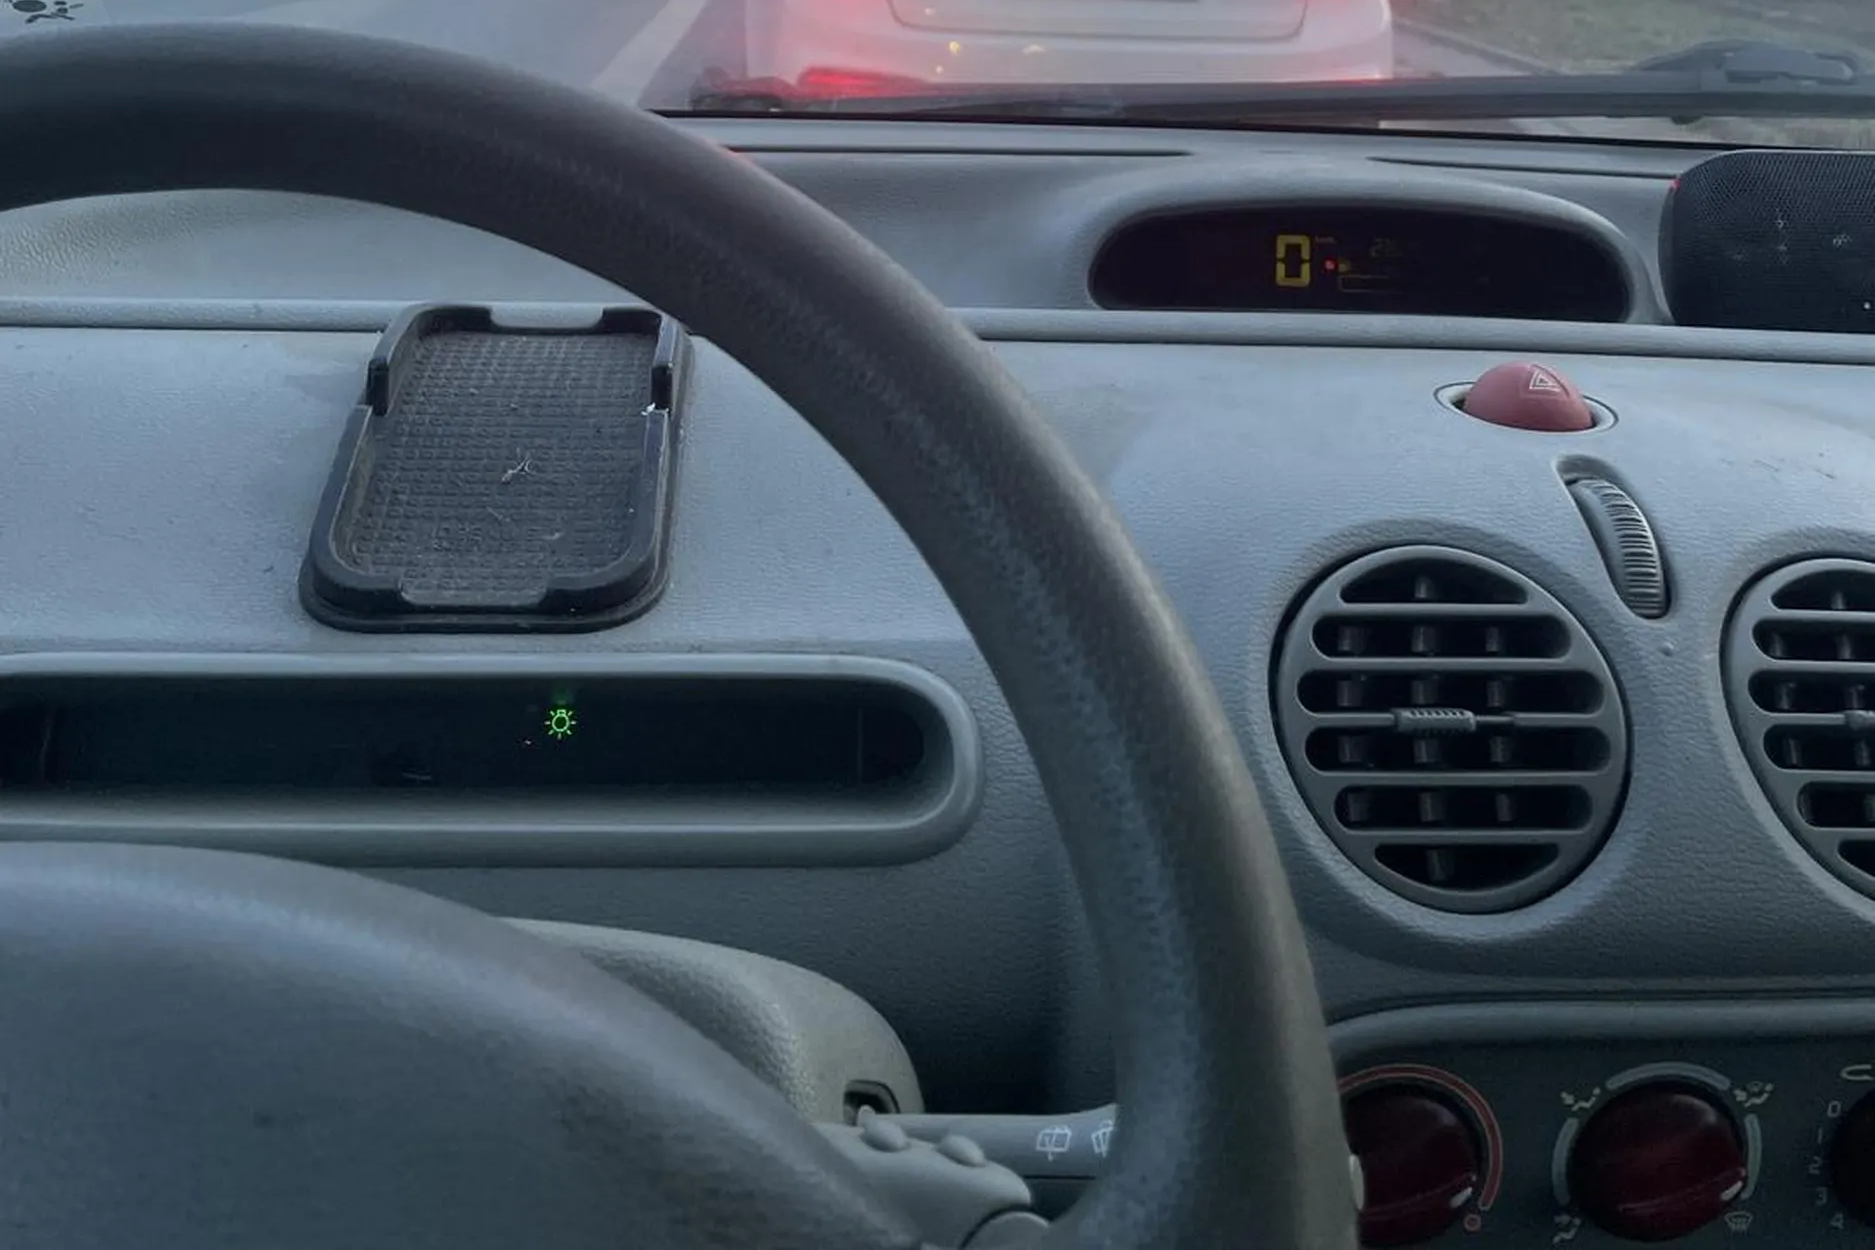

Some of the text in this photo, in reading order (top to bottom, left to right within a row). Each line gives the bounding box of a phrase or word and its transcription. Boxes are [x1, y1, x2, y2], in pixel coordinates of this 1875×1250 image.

[1276, 234, 1310, 286] 0
[1827, 1100, 1842, 1118] 0
[1816, 1127, 1824, 1144] 1
[1808, 1156, 1823, 1175] 2
[1814, 1187, 1828, 1206] 3
[1830, 1212, 1844, 1230] 4
